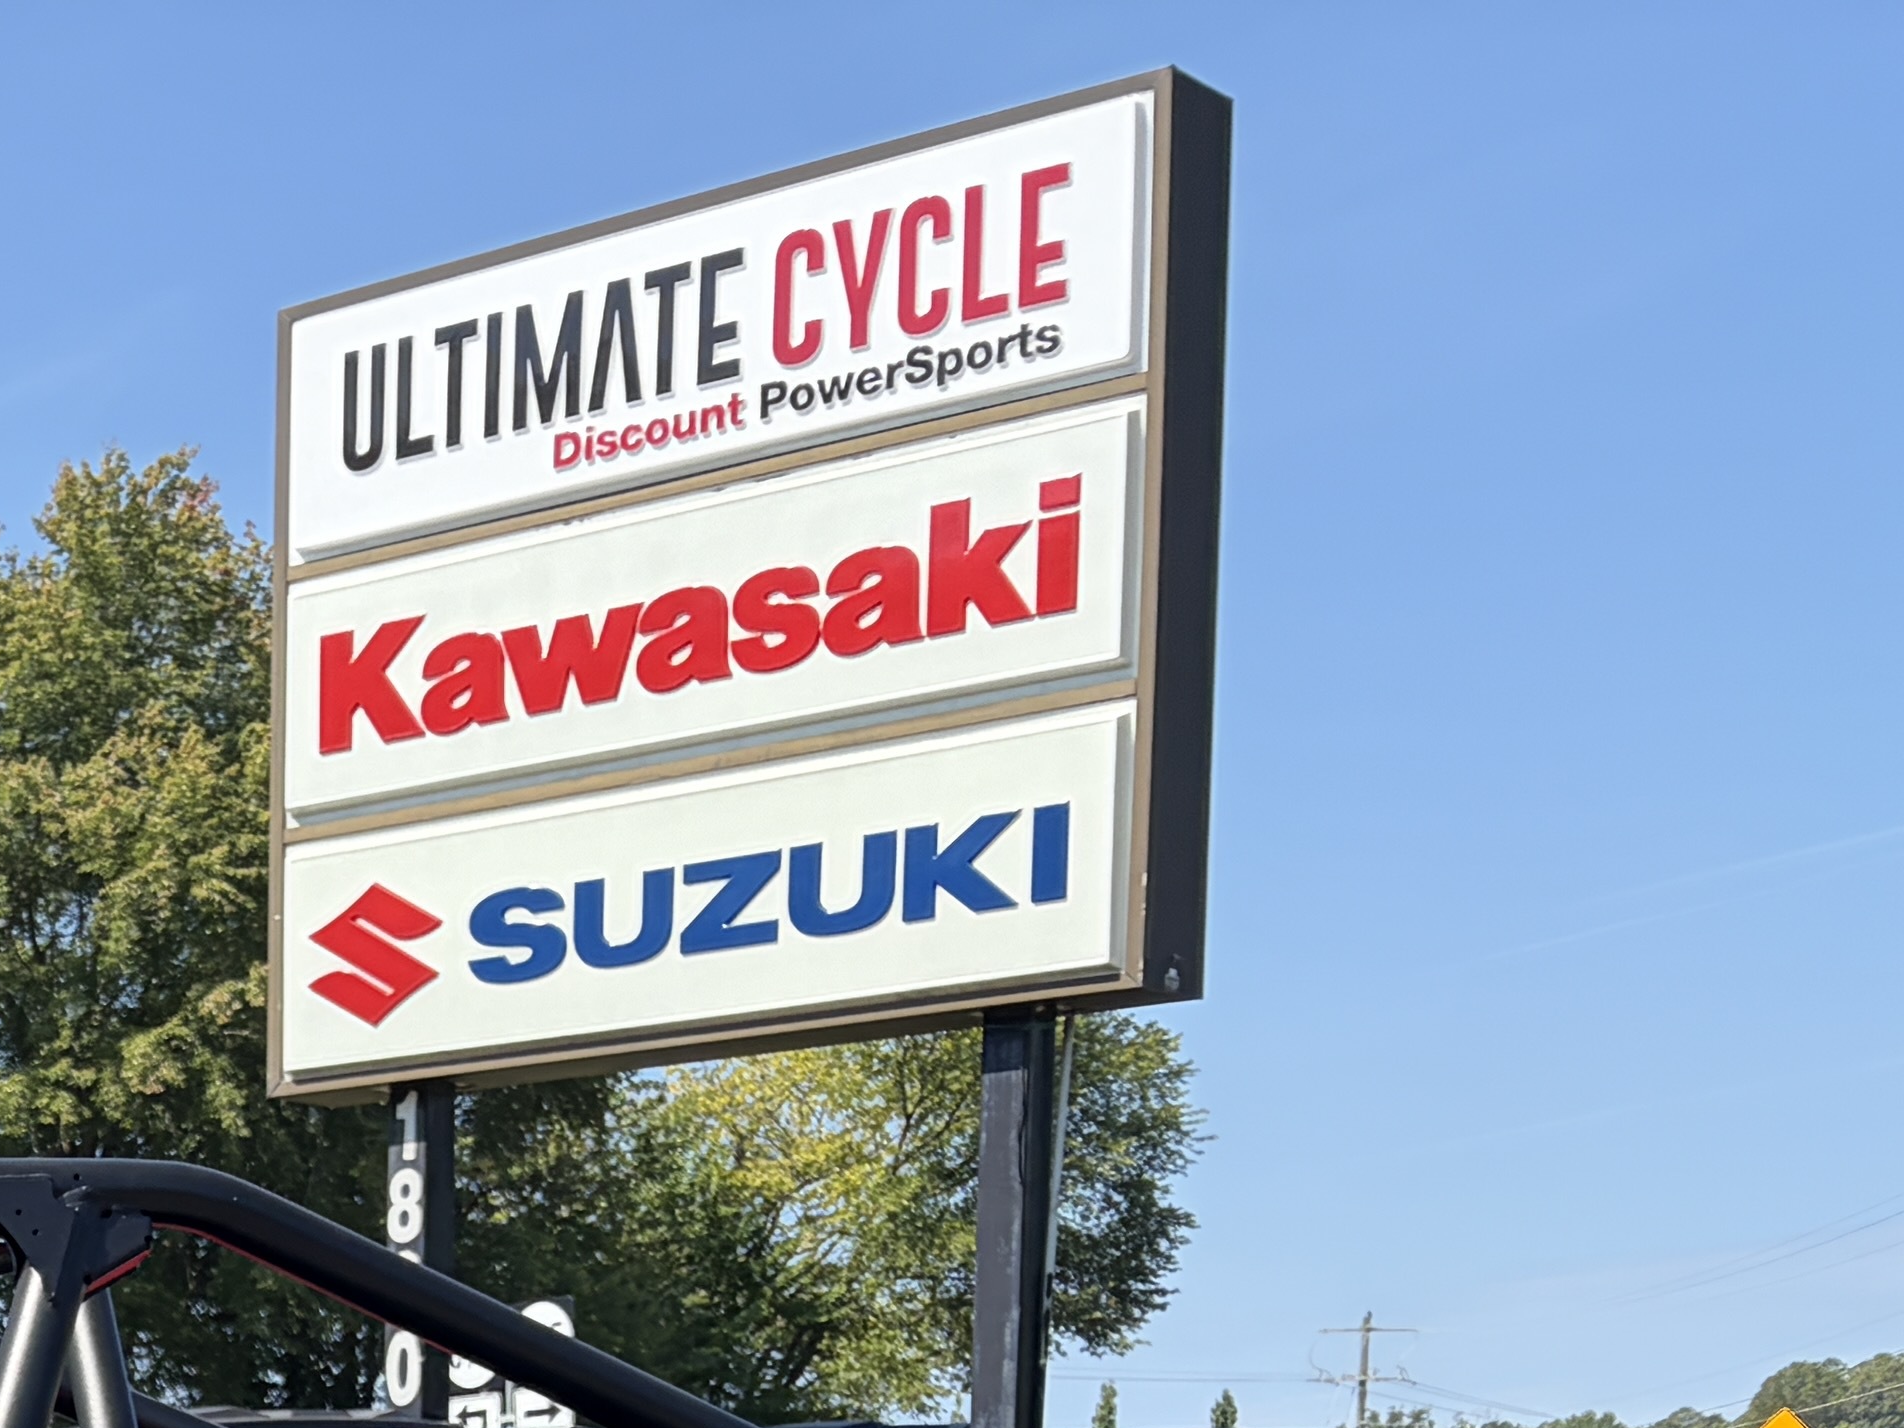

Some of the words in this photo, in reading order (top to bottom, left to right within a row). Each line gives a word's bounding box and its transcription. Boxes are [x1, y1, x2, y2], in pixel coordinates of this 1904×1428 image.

[341, 247, 745, 474] ULTIMATE
[770, 162, 1072, 367] CYCLE
[552, 395, 744, 470] Discount
[758, 321, 1062, 421] PowerSports
[318, 472, 1084, 755] Kawasaki
[467, 801, 1072, 985] SUZUKI
[386, 1089, 424, 1407] 180
